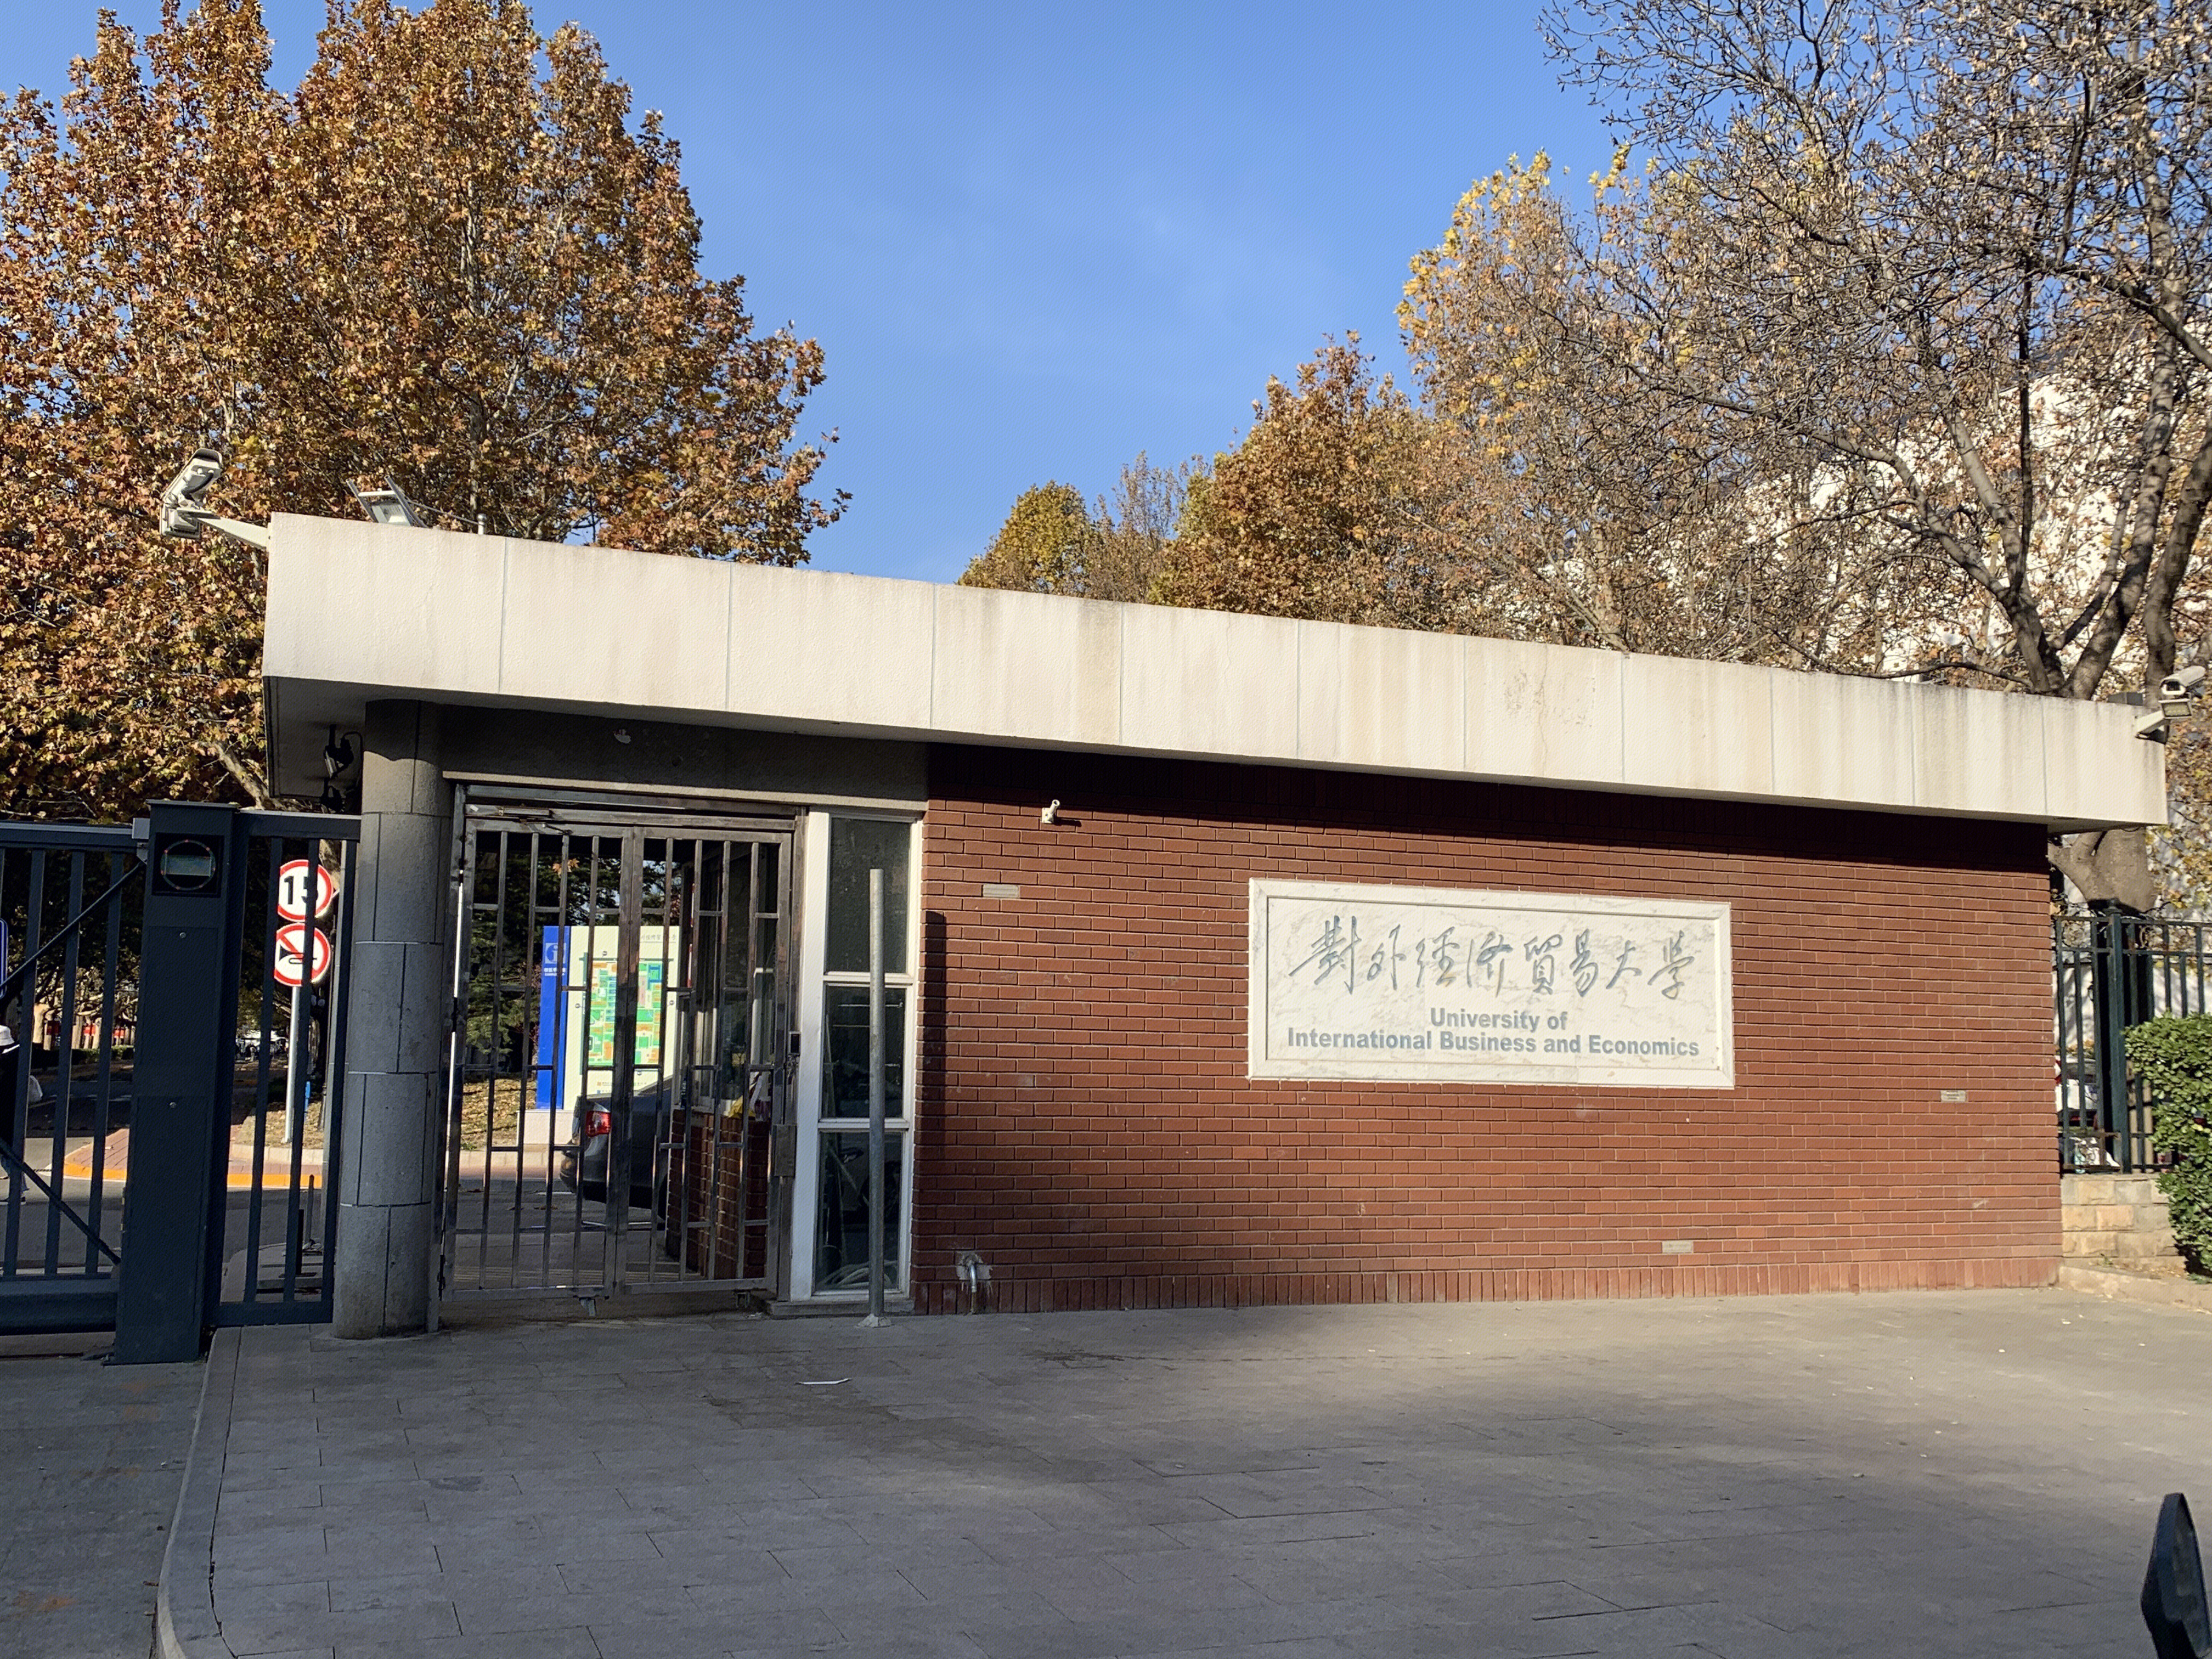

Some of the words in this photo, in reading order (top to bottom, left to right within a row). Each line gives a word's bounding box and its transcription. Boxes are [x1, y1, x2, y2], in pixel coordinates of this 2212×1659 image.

[1430, 1007, 1541, 1033] University
[1547, 1011, 1568, 1030] of
[1288, 1027, 1432, 1049] International
[1440, 1031, 1536, 1052] Business
[1543, 1035, 1581, 1053] and
[1588, 1035, 1700, 1057] Economics
